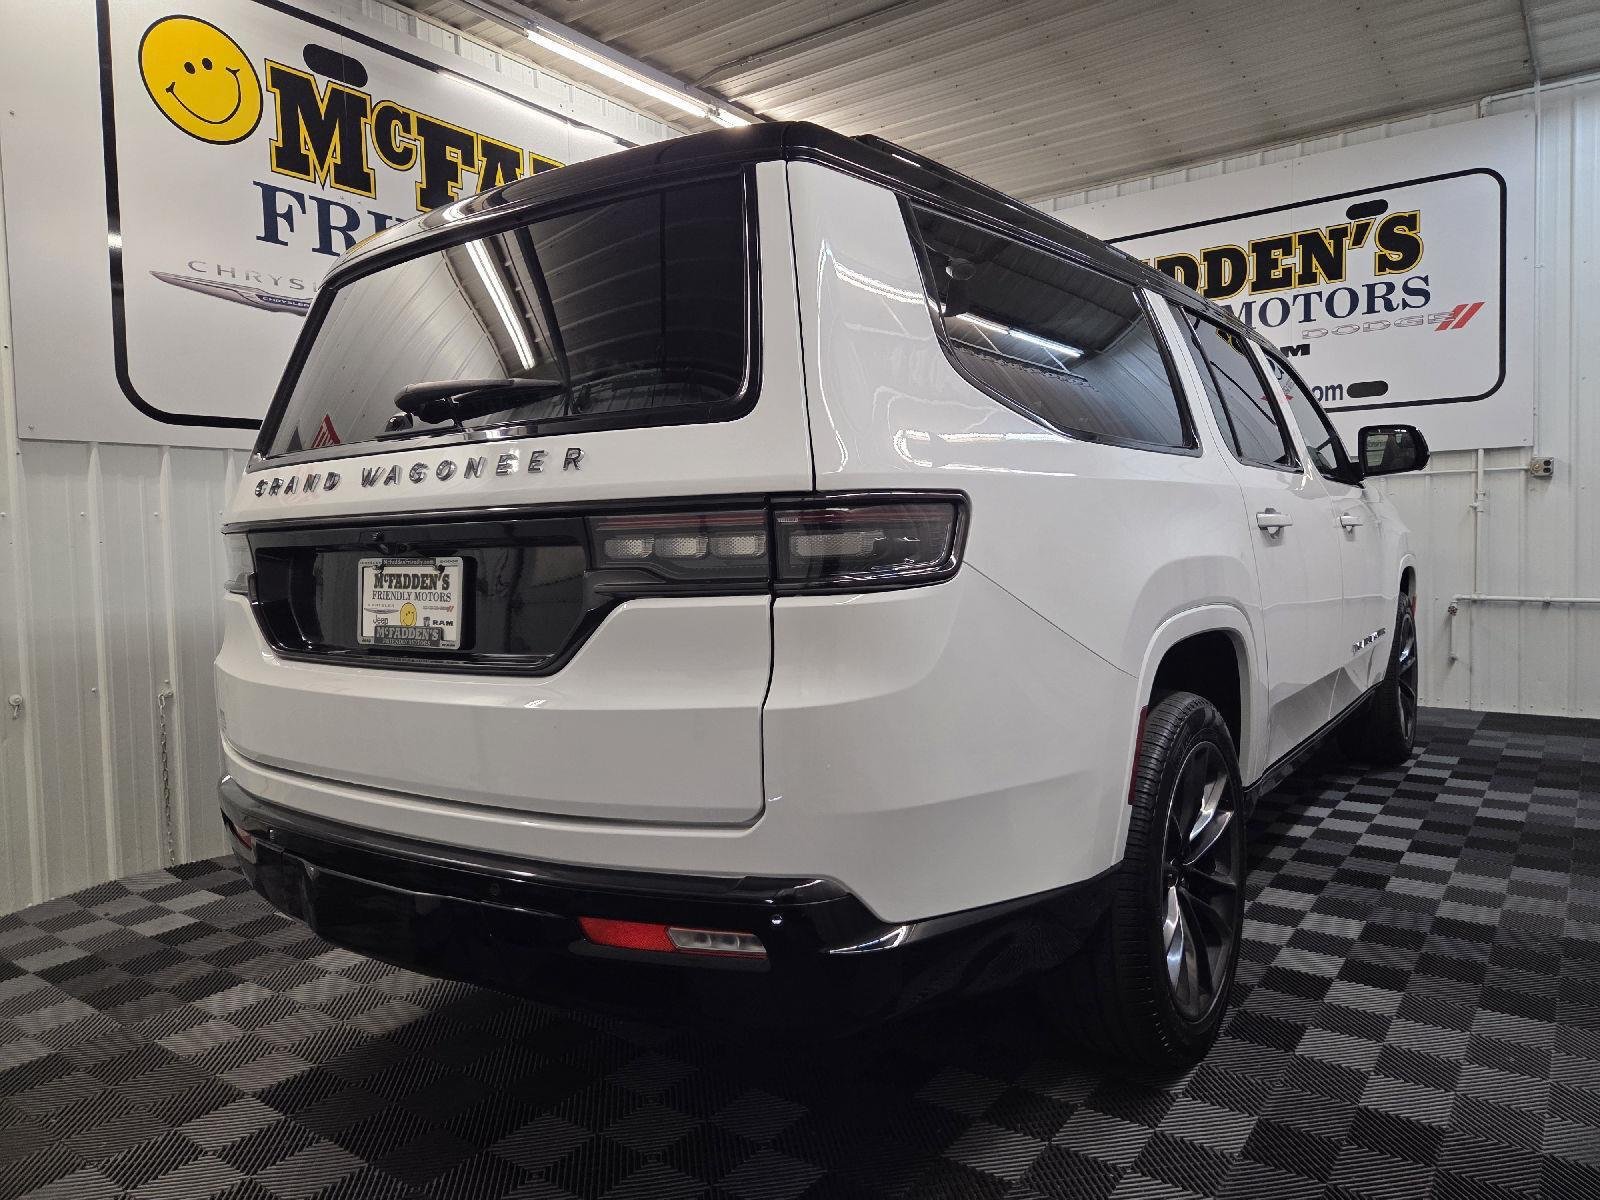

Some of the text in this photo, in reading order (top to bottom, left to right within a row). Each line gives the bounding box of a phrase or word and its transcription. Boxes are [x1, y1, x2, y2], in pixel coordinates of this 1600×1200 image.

[1223, 275, 1434, 331] MOTORS
[252, 446, 585, 498] GRAND WAGONEER
[372, 591, 452, 603] FRIENDLY MOTORS
[373, 615, 389, 626] Jeep
